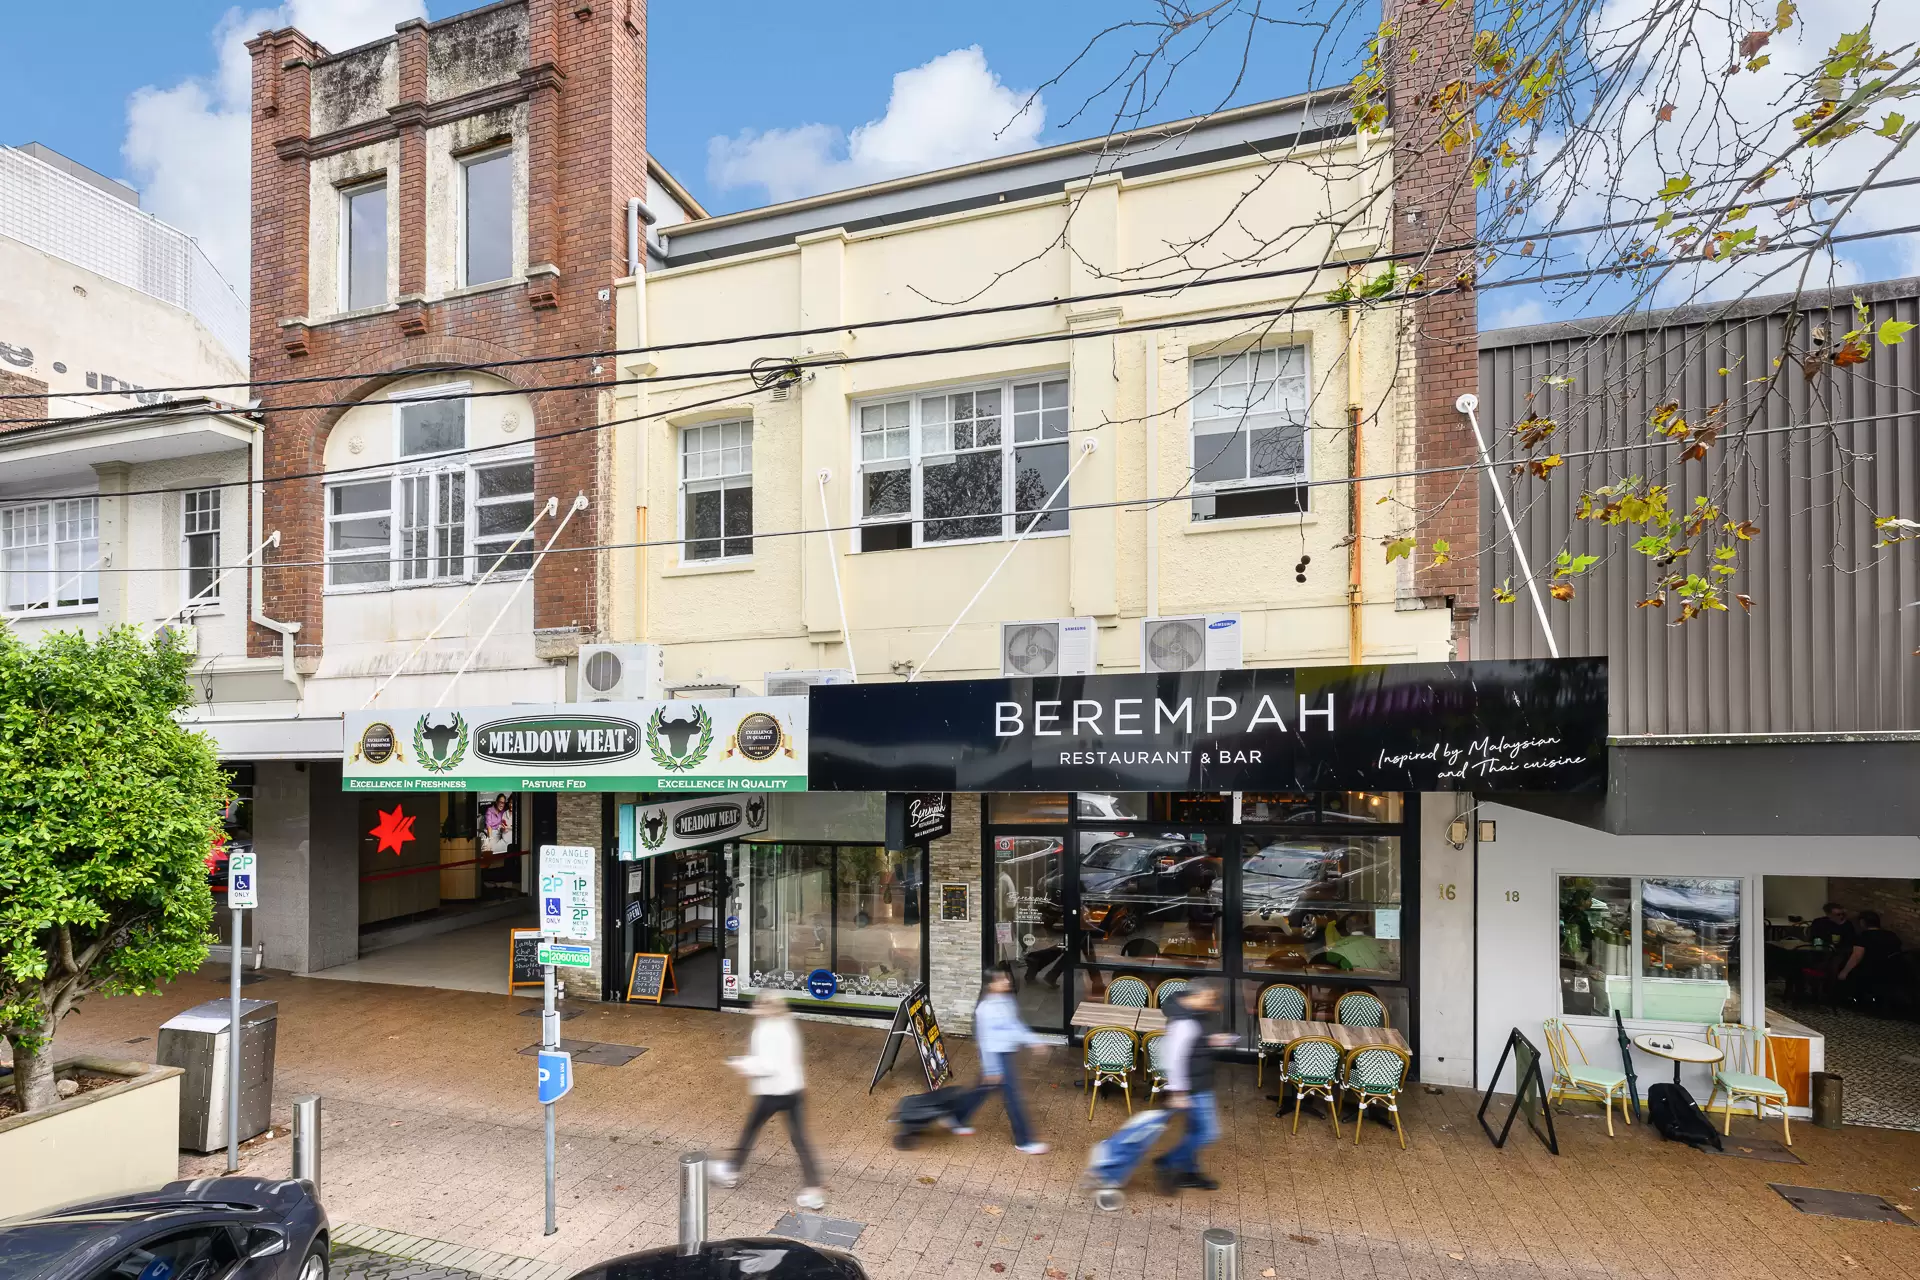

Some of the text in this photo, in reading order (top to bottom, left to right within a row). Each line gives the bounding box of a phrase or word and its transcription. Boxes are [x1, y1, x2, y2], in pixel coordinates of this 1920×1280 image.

[995, 693, 1335, 737] BEREMPAH
[488, 728, 628, 754] MEADOW MEAT
[1060, 750, 1262, 765] RESTAURANT & BAR
[1378, 735, 1561, 769] Inspired by Malaysian
[1437, 756, 1587, 779] and Thai cuisine
[350, 779, 403, 788] EXCELLENCE
[415, 779, 467, 788] FRESHNESS
[521, 779, 587, 788] PASTURE FED
[657, 779, 725, 789] EXCELLENCE
[741, 779, 788, 789] QUALITY
[680, 809, 738, 833] MEADOW MEAT
[545, 848, 589, 858] 60 ANGLE
[231, 856, 253, 870] 2P
[542, 877, 563, 892] 2P
[573, 879, 587, 891] 1P
[1438, 884, 1456, 900] 16
[1505, 890, 1520, 902] 18
[572, 909, 589, 920] 2P
[551, 952, 590, 964] 20601039
[538, 1067, 551, 1088] P
